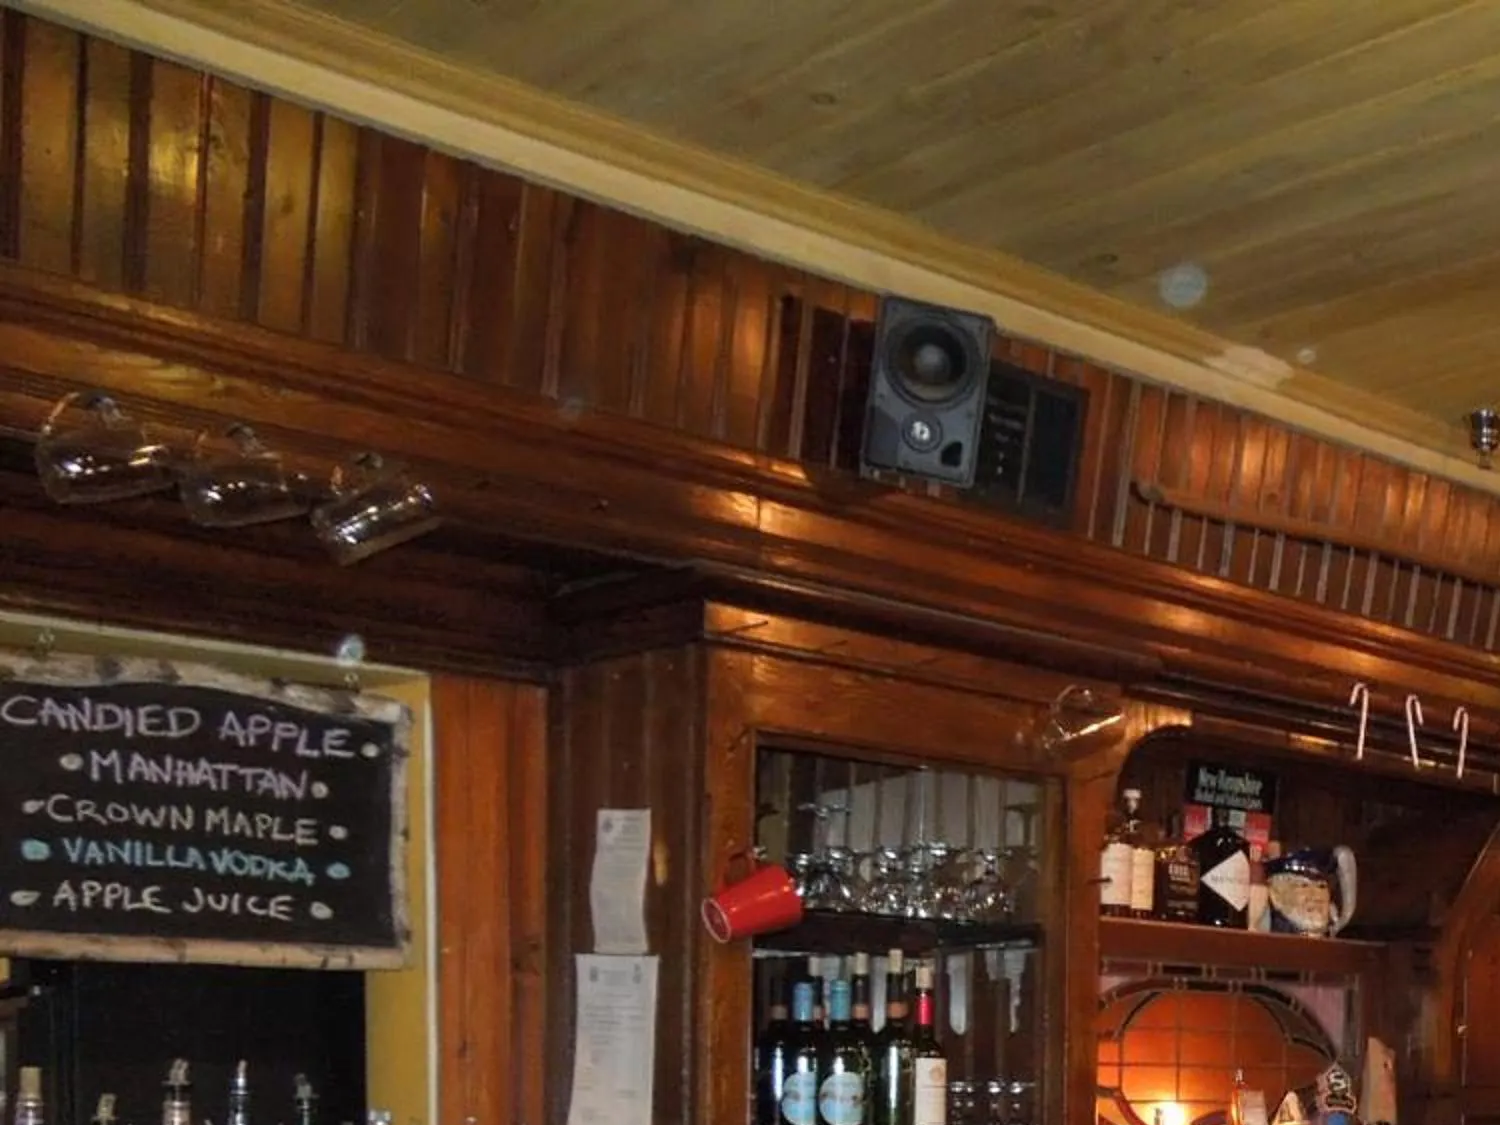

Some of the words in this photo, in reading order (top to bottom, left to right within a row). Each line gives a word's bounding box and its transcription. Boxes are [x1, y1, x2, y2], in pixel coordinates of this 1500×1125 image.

[0, 696, 200, 738] CANDIED
[218, 709, 355, 758] APPLE
[90, 749, 307, 800] MANHATTAN
[46, 793, 195, 831] CROWN
[205, 806, 319, 846] MAPLE
[62, 837, 205, 871] VANILLA
[210, 847, 314, 886] VODKA
[53, 879, 172, 914] APPLE
[182, 885, 293, 921] JUICE
